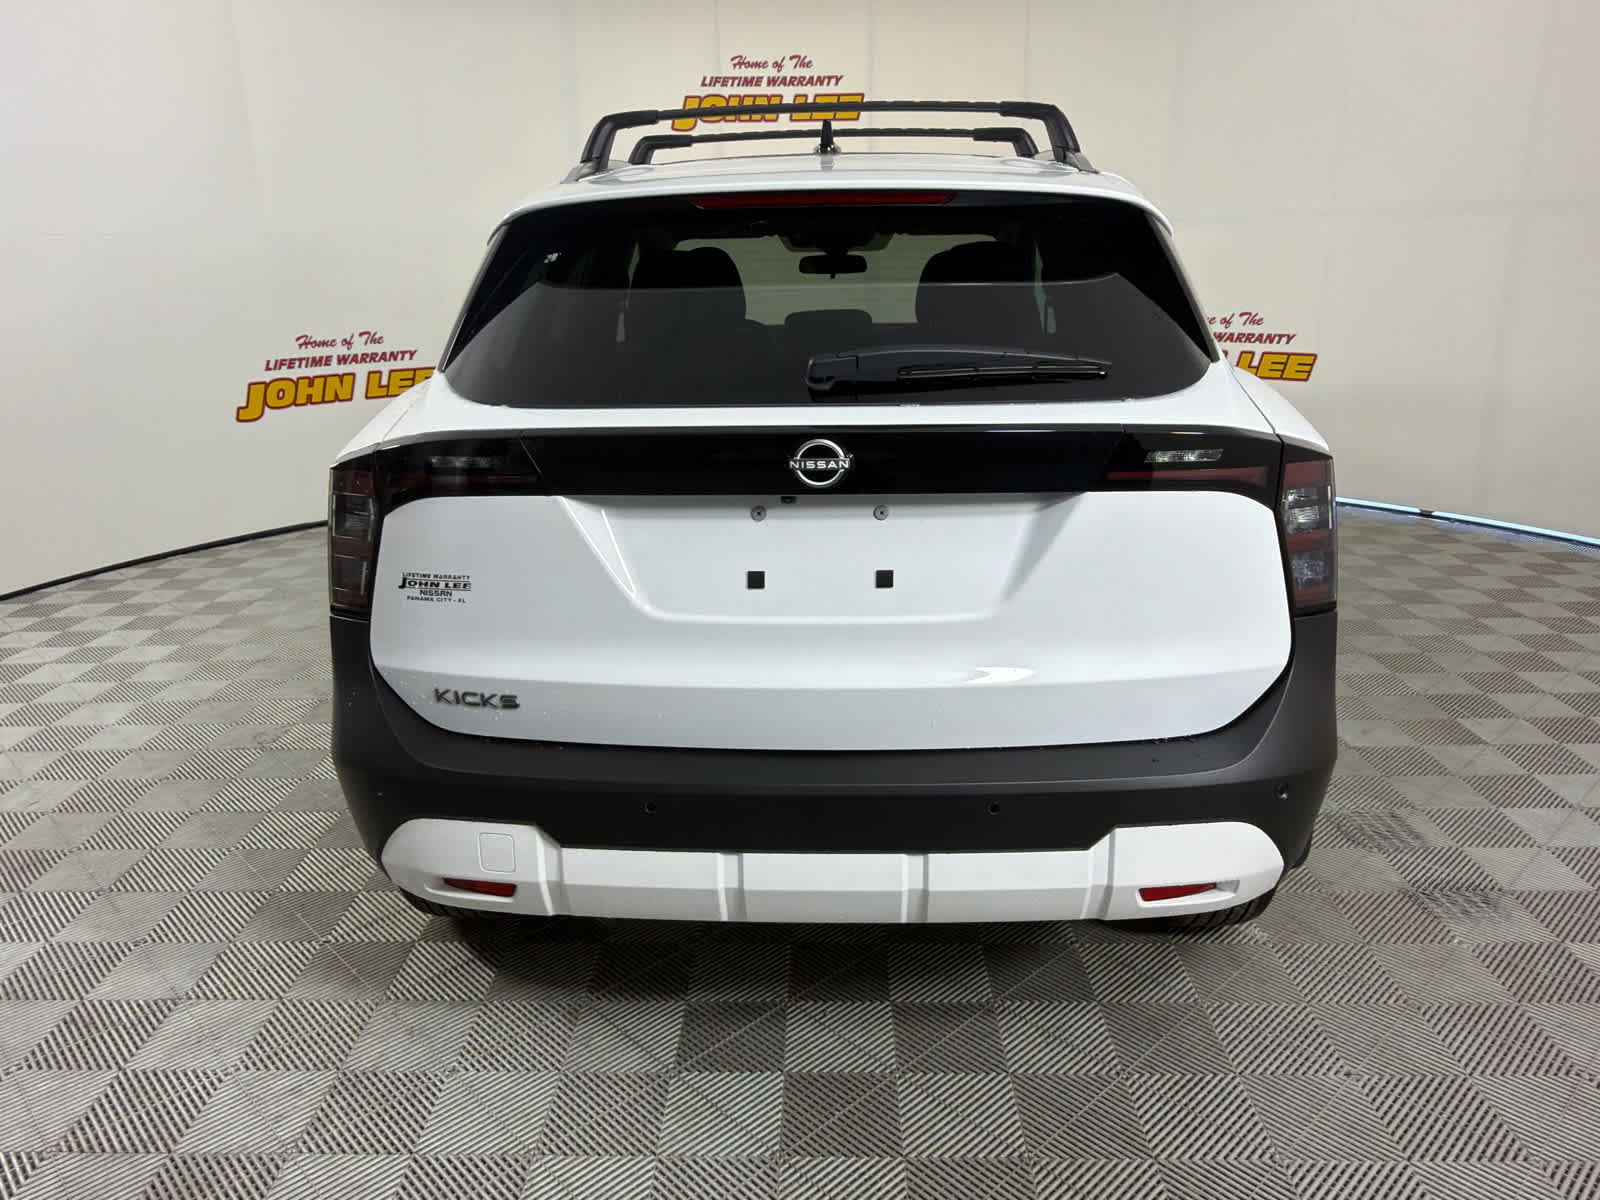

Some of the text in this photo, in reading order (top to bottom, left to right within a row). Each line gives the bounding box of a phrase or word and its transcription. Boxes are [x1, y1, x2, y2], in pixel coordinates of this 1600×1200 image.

[730, 54, 813, 72] Home of The
[700, 75, 844, 87] LIFETIME WARRANTY
[671, 93, 865, 132] JOHN LEE
[1220, 313, 1235, 328] of
[1239, 311, 1264, 326] The
[295, 331, 384, 350] Home of The
[1213, 332, 1296, 344] WARRANTY
[264, 350, 418, 371] LIFETIME WARRANTY
[1236, 350, 1318, 382] LEE
[236, 372, 356, 423] JOHN
[789, 460, 849, 469] NISSAN
[398, 577, 440, 589] JOHN
[434, 688, 520, 709] KICKS
